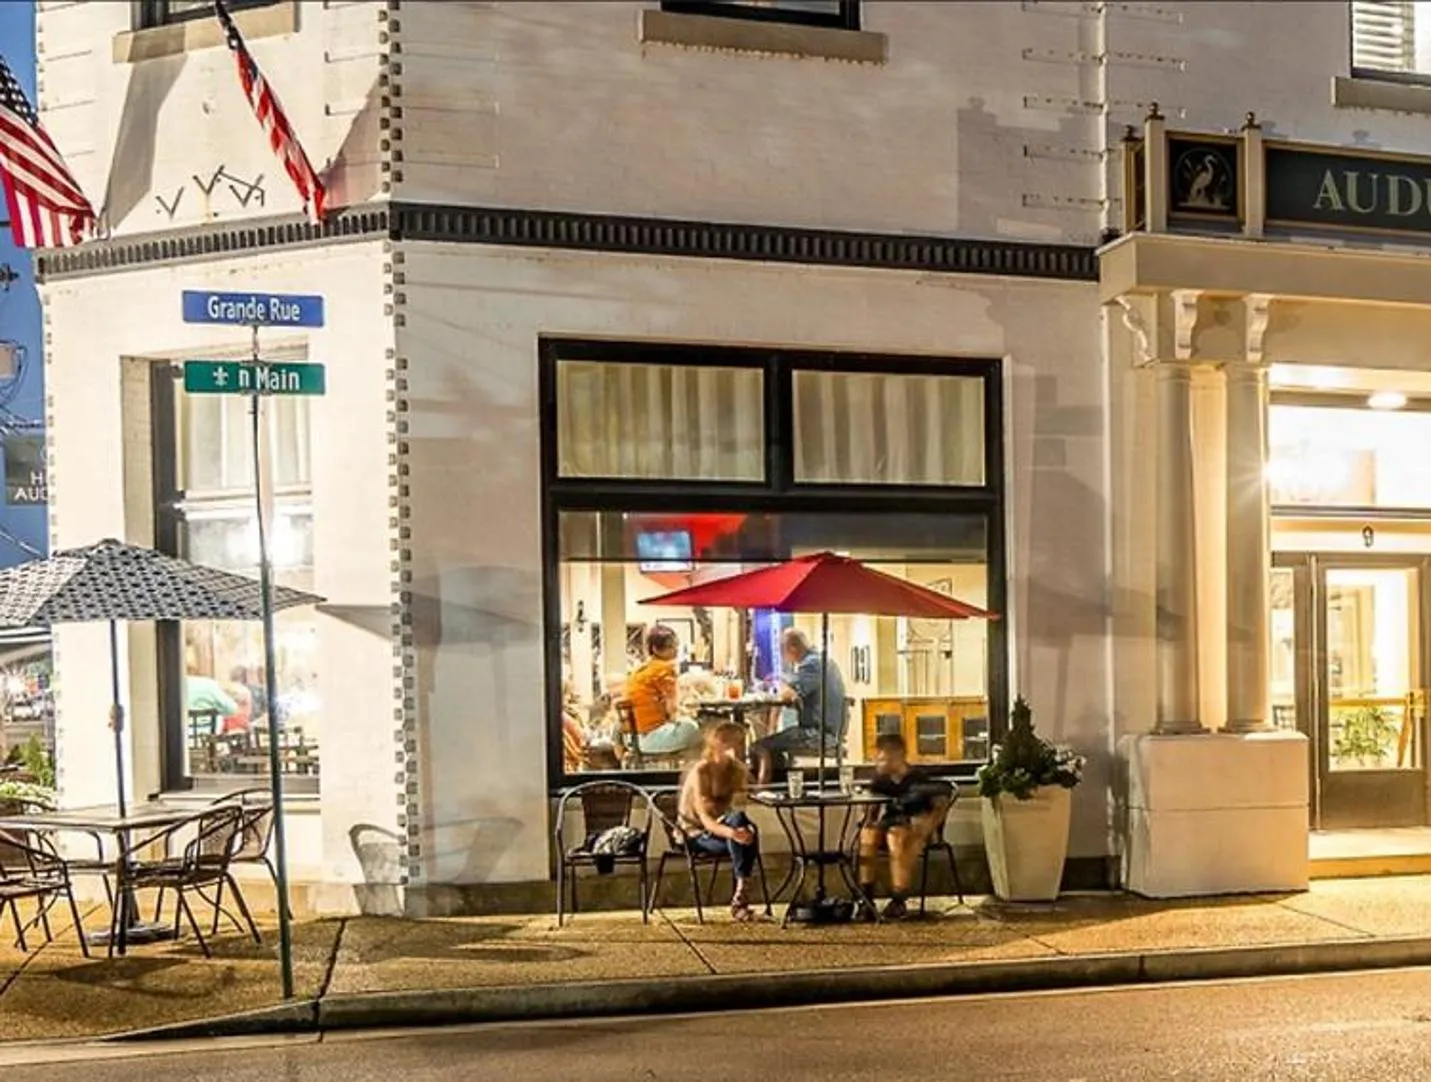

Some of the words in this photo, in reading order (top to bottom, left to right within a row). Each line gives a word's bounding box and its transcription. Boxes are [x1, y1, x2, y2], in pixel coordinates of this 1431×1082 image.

[207, 295, 266, 320] Grande
[269, 297, 301, 321] Rue
[255, 366, 300, 391] Main
